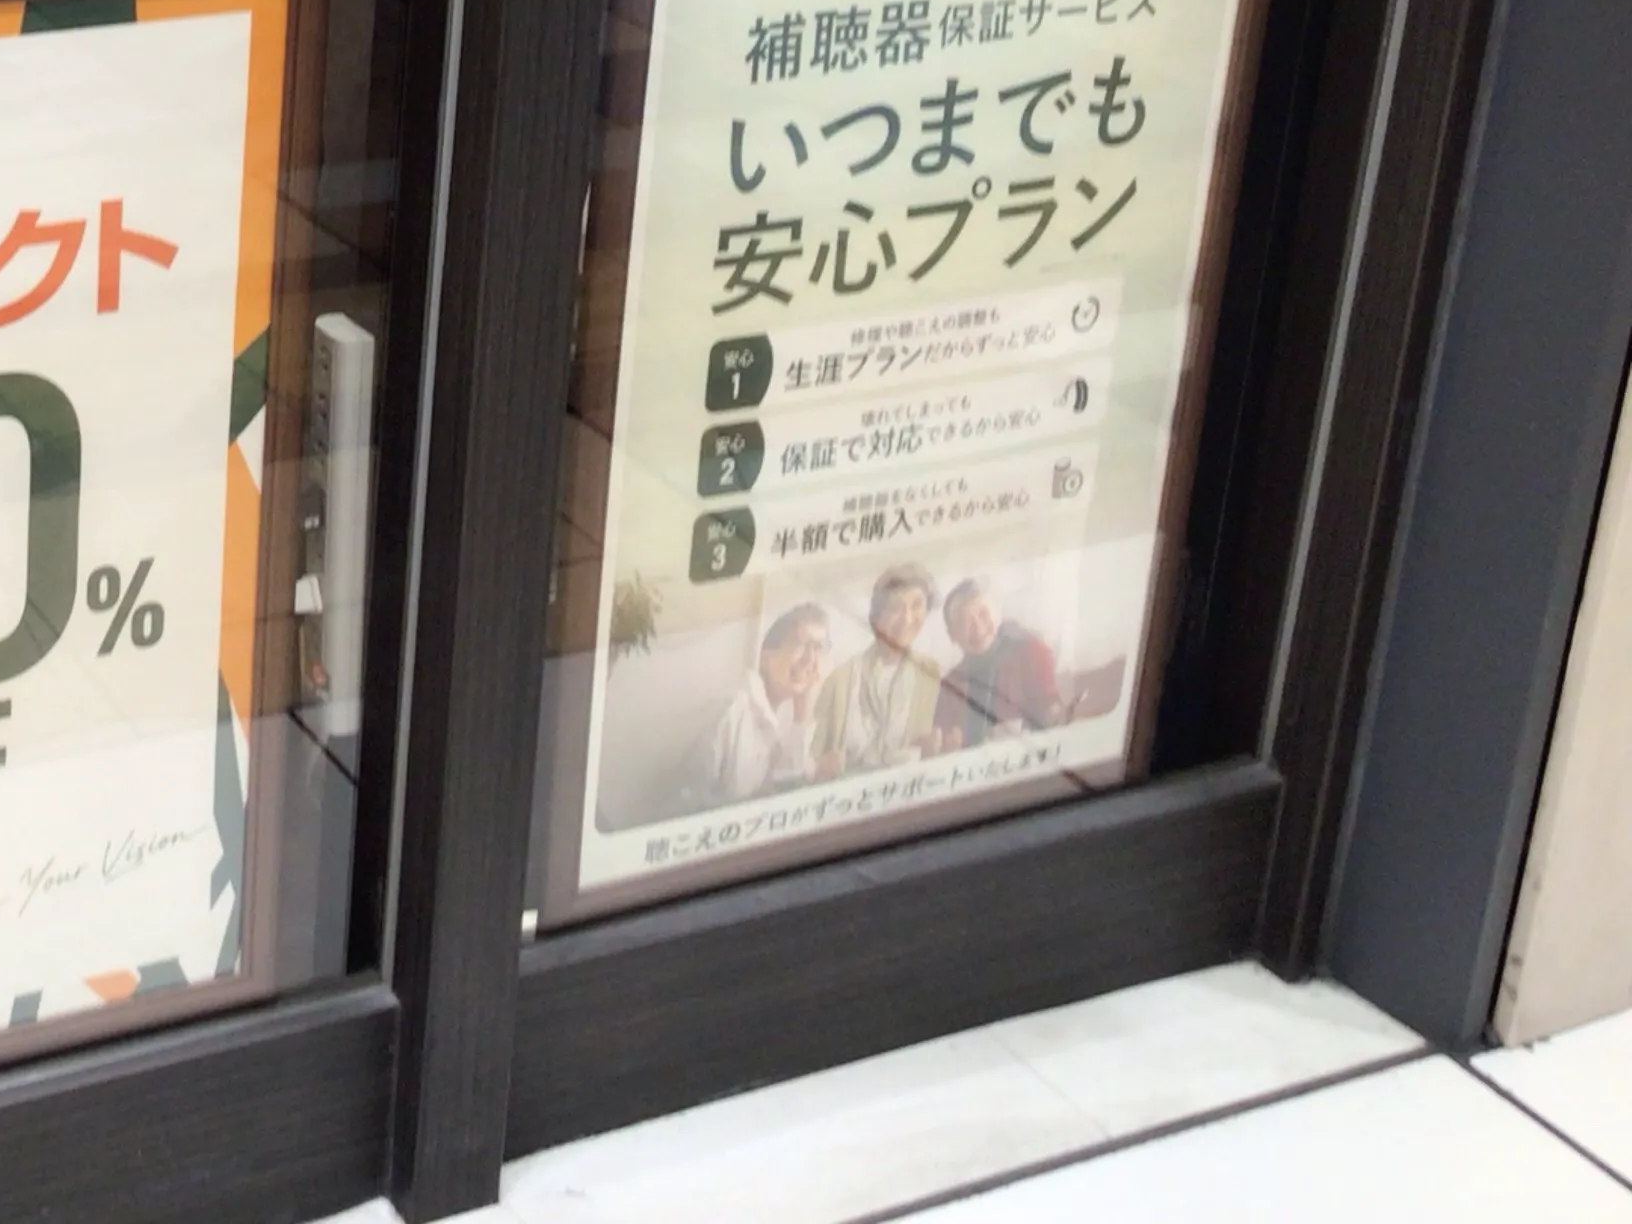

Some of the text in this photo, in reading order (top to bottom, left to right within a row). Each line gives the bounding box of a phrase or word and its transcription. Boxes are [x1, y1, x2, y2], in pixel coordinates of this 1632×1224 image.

[728, 54, 1147, 194] いつまでも
[709, 176, 1139, 317] 安心プラン
[783, 323, 1056, 392] 生涯プランだからずっと安心
[719, 458, 736, 487] 2
[779, 409, 1042, 477] 保証で対応できるから安心
[710, 543, 727, 574] 3
[770, 491, 1032, 560] 半額で購入できるから安心
[18, 854, 93, 919] Your
[100, 822, 208, 884] Vision
